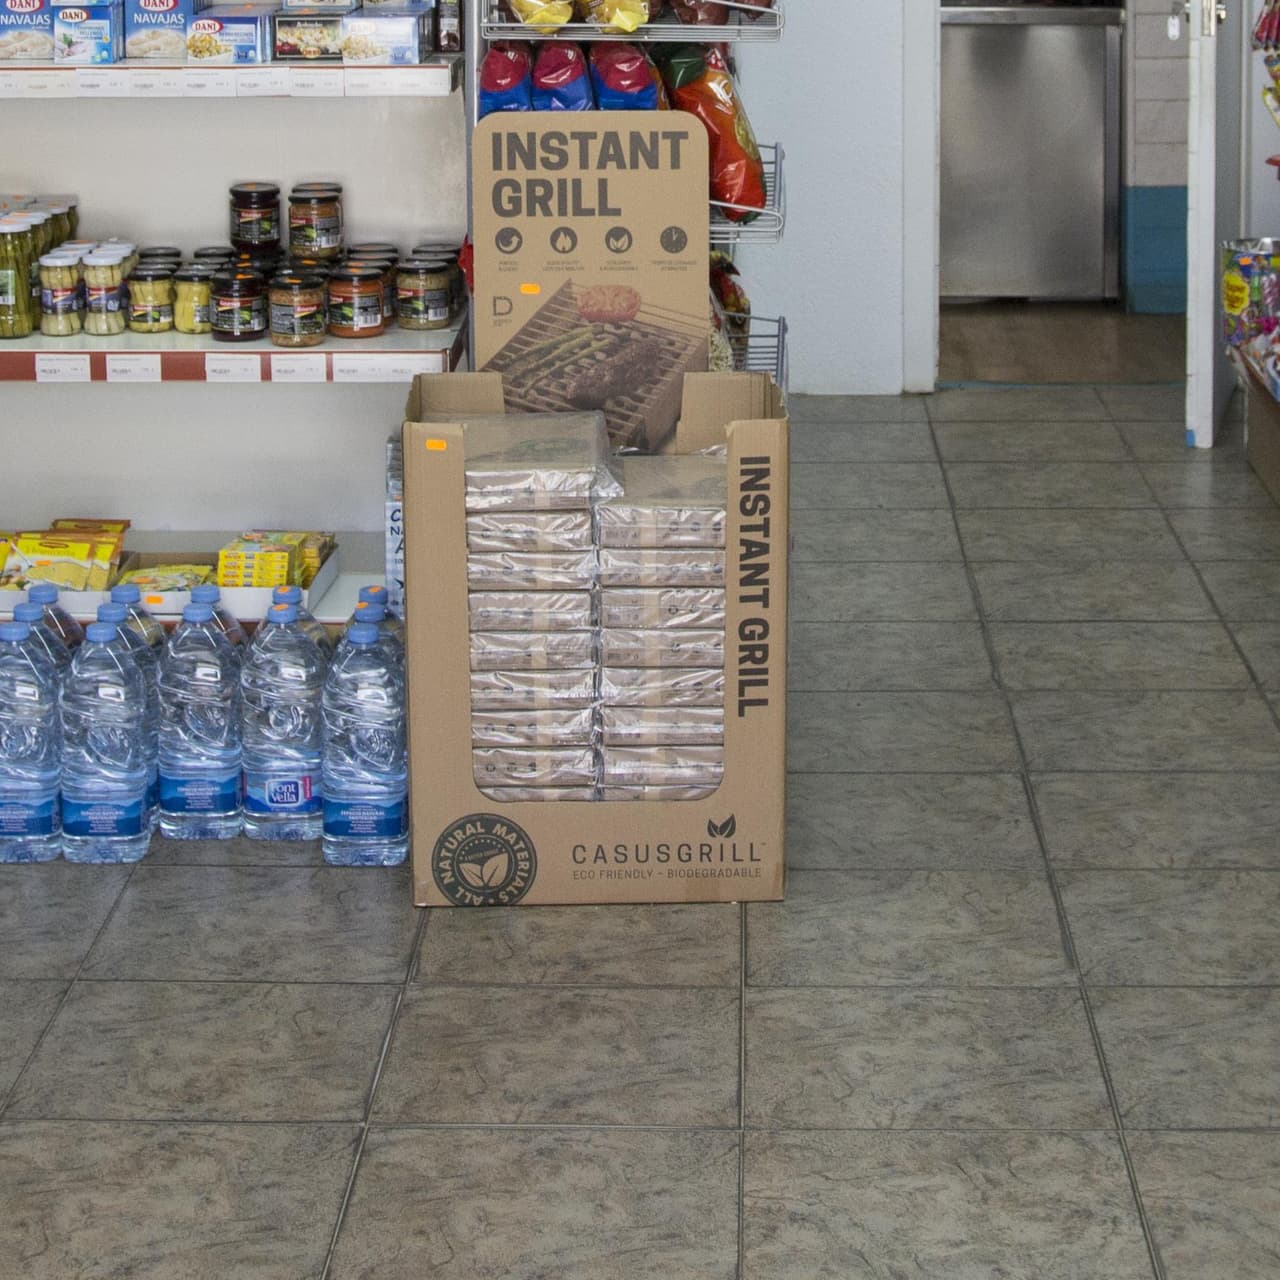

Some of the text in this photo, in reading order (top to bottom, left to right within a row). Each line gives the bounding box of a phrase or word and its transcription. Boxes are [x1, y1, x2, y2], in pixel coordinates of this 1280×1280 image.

[0, 14, 50, 25] NAVAJAS
[61, 11, 84, 20] DANI
[133, 13, 185, 24] NAVAJAS
[194, 22, 218, 32] DANI
[491, 130, 690, 172] INSTANT
[491, 177, 622, 218] GRILL
[737, 455, 772, 718] INSTANT GRILL
[271, 793, 298, 804] Vella
[572, 842, 763, 865] CASUSGRILL
[440, 822, 530, 907] NATURAL MATERIALS ALL
[573, 867, 762, 881] ECO FRIENDLY BIODEGRADABLE
